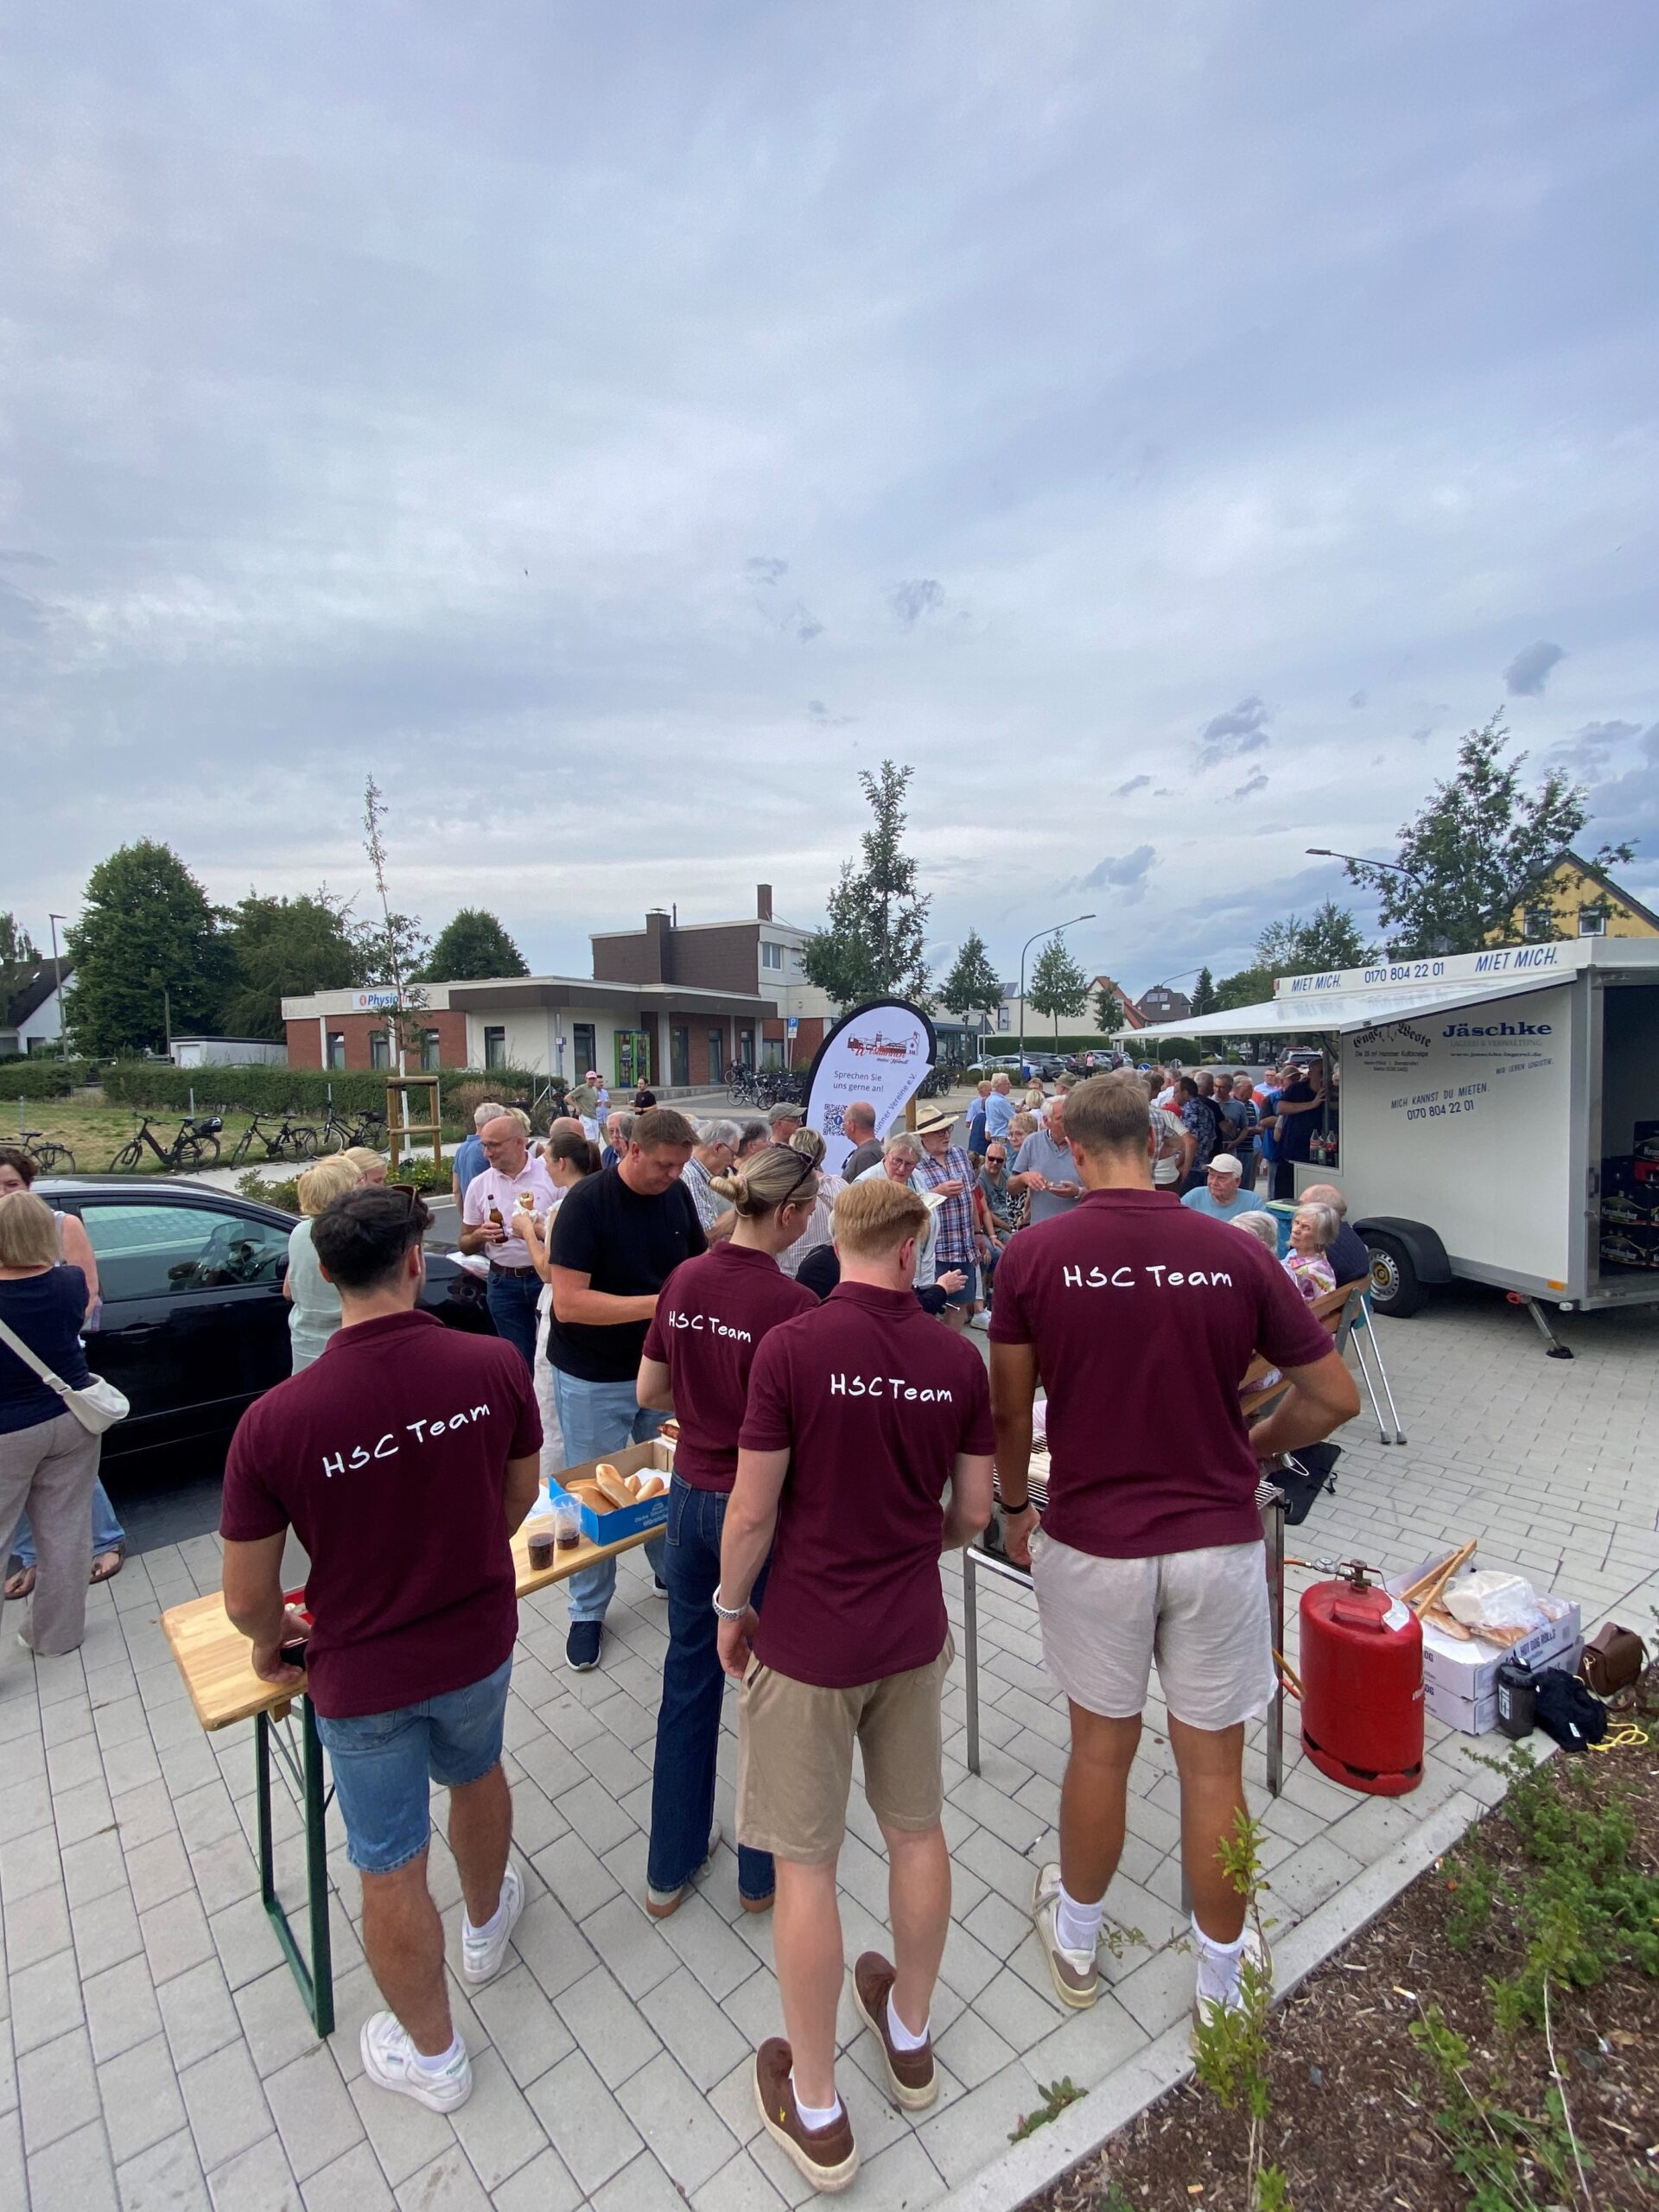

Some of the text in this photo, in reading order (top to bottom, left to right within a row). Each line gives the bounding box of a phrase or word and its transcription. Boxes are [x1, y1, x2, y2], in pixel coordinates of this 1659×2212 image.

[1475, 947, 1558, 973] MIET MICH.
[1291, 974, 1341, 993] MIET MICH.
[1364, 962, 1445, 984] 0170 804 22 01
[1442, 1021, 1553, 1038] Jäschke
[834, 1071, 882, 1082] Sprechen Sie
[849, 1084, 870, 1092] gerne
[888, 1085, 908, 1110] Vereine
[1391, 1097, 1408, 1109] MICH
[1412, 1091, 1439, 1104] KANNST
[1443, 1089, 1453, 1099] DU
[1407, 1099, 1474, 1121] 0170 804 22 01
[1063, 1264, 1232, 1287] HSC Team
[669, 1311, 752, 1343] HSC Team
[830, 1373, 953, 1403] HSC Team
[322, 1403, 490, 1478] HSC Team
[1520, 1642, 1529, 1656] HOT
[1530, 1637, 1541, 1650] DOG
